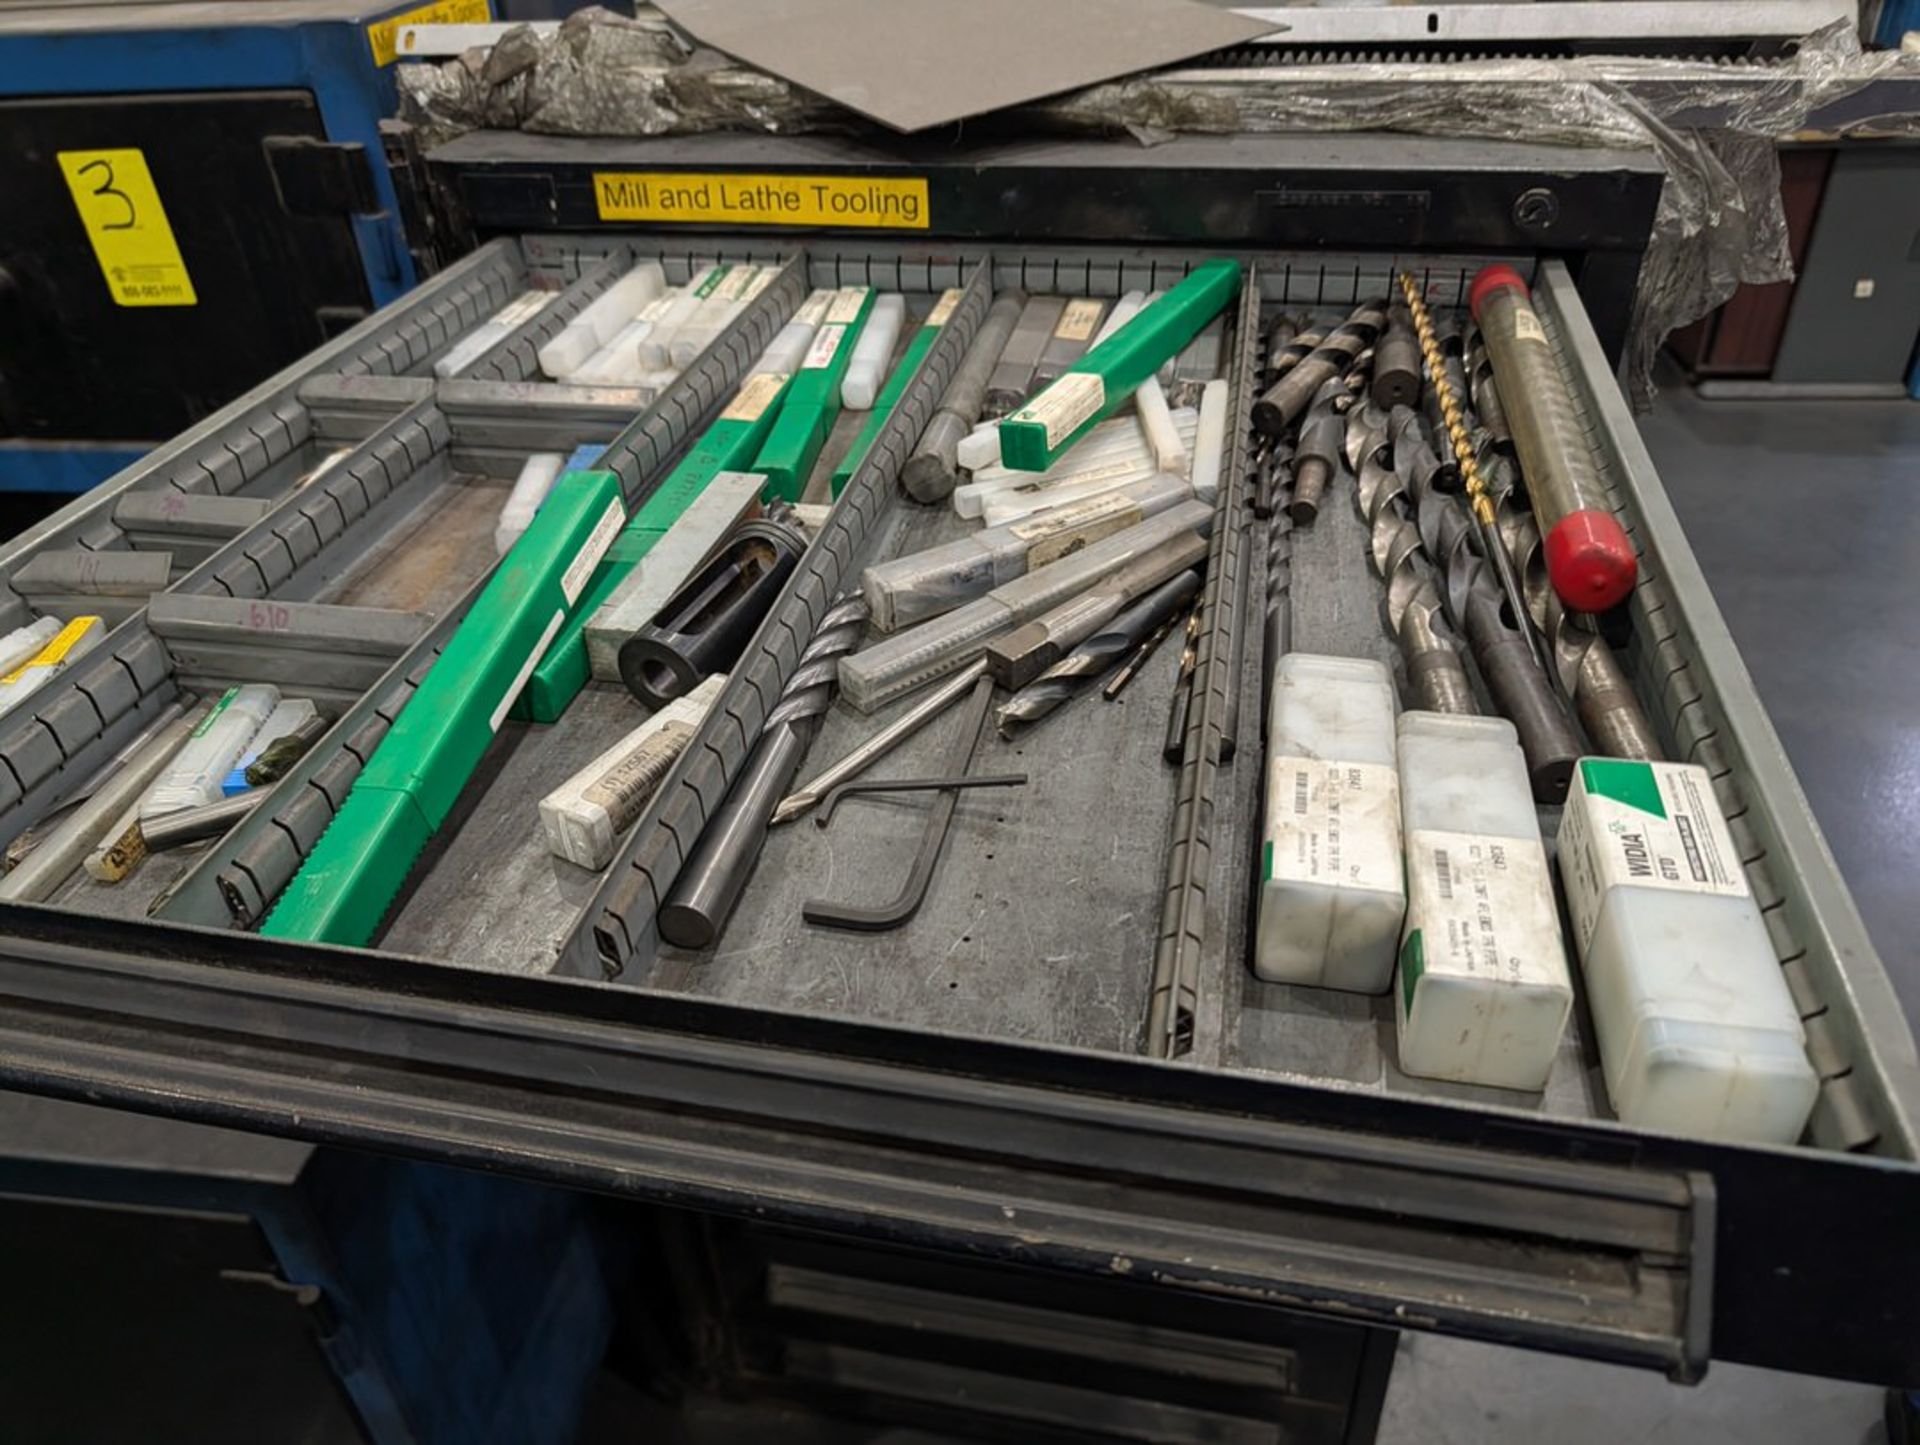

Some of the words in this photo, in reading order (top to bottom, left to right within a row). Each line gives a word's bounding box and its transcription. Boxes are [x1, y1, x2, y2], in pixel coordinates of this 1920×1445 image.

[78, 159, 136, 231] 3
[603, 182, 649, 209] Mill
[659, 184, 711, 209] and
[720, 183, 801, 212] Lathe
[810, 184, 919, 222] Tooling
[1620, 833, 1652, 876] WIDIA
[1660, 857, 1680, 880] GTD
